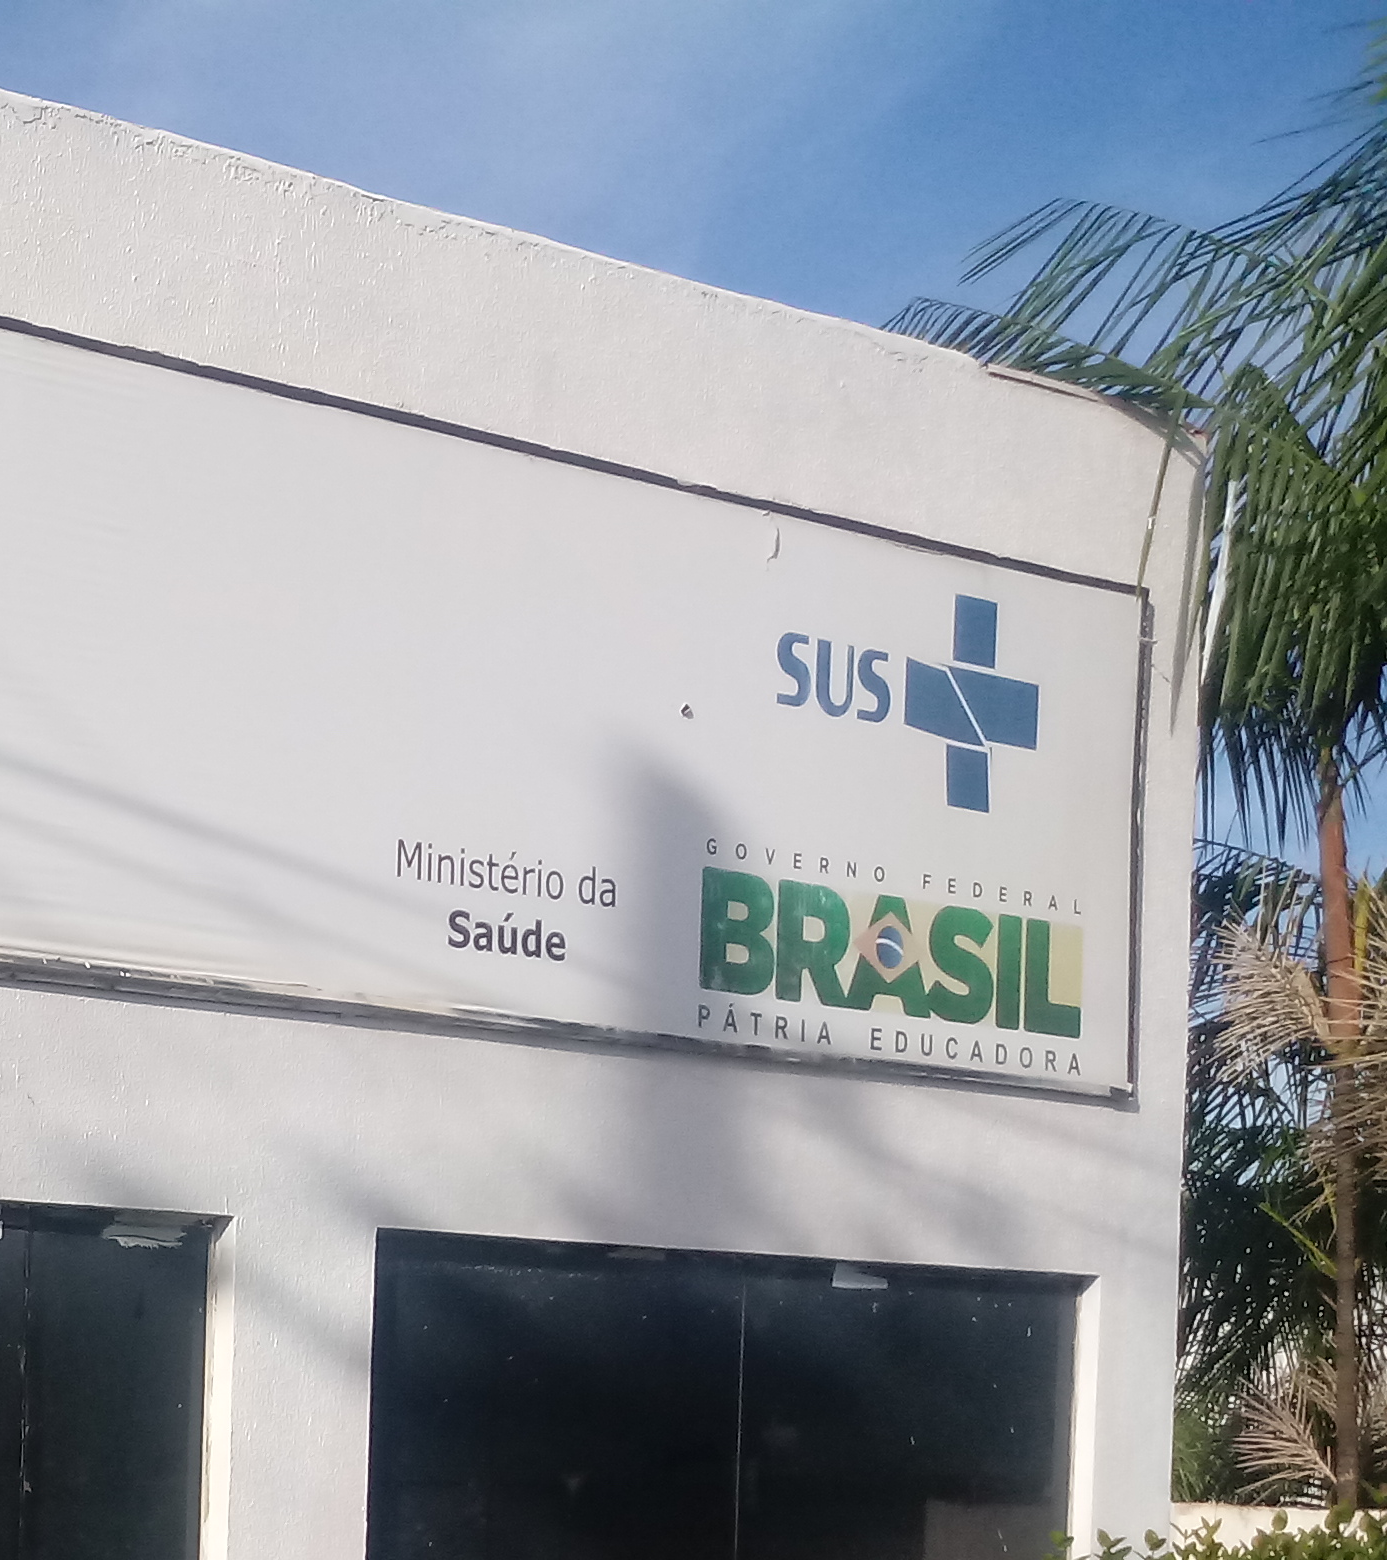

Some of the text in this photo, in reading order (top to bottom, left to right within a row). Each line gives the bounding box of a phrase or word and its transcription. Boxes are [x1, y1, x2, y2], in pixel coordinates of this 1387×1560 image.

[776, 631, 891, 723] SUS
[395, 838, 618, 908] Ministério da
[705, 837, 1083, 914] GOVERNO FEDERAL
[447, 910, 567, 962] Saúde
[700, 865, 1083, 1039] BRASIL
[697, 1001, 1082, 1076] PÁTRIA EDUCADORA
